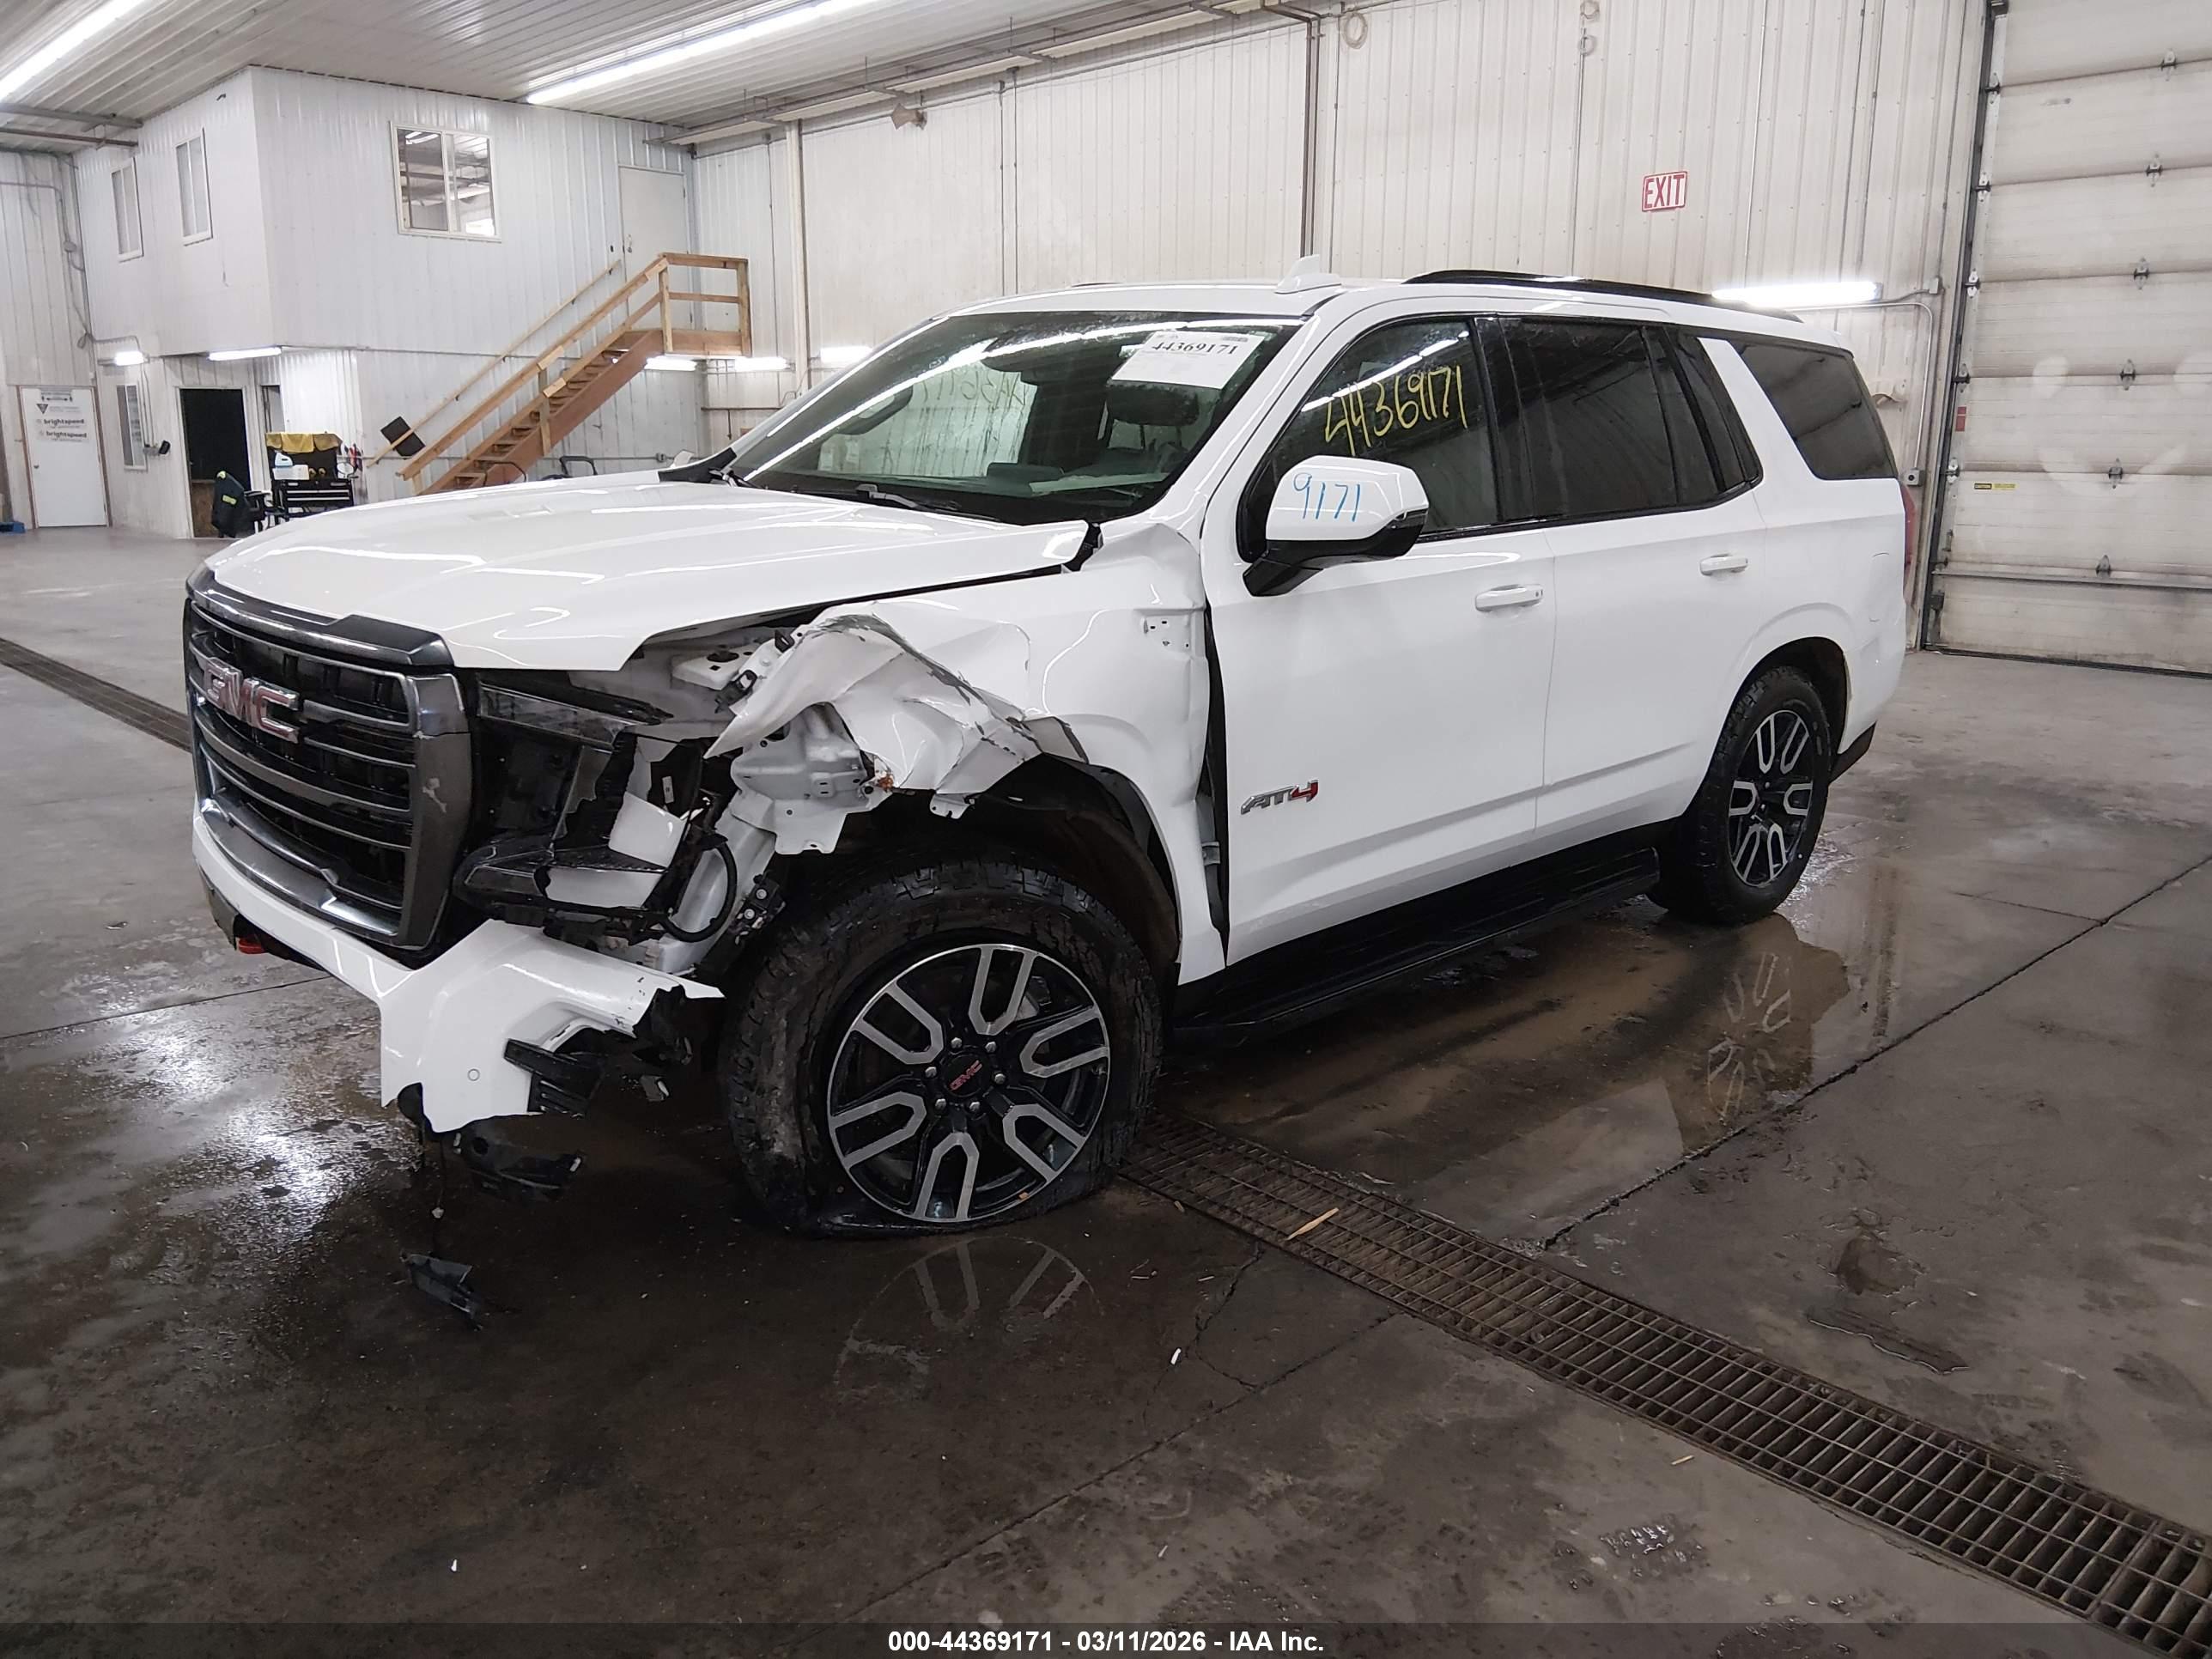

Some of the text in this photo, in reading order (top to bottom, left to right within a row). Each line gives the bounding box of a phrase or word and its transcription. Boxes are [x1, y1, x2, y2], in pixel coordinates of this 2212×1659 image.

[1644, 173, 1685, 209] EXIT
[1152, 341, 1239, 356] 44369171
[1324, 364, 1469, 457] 44369171
[1292, 471, 1362, 523] 9171
[204, 657, 301, 744] GMC
[1240, 778, 1320, 816] AT4
[949, 1060, 983, 1091] GMC
